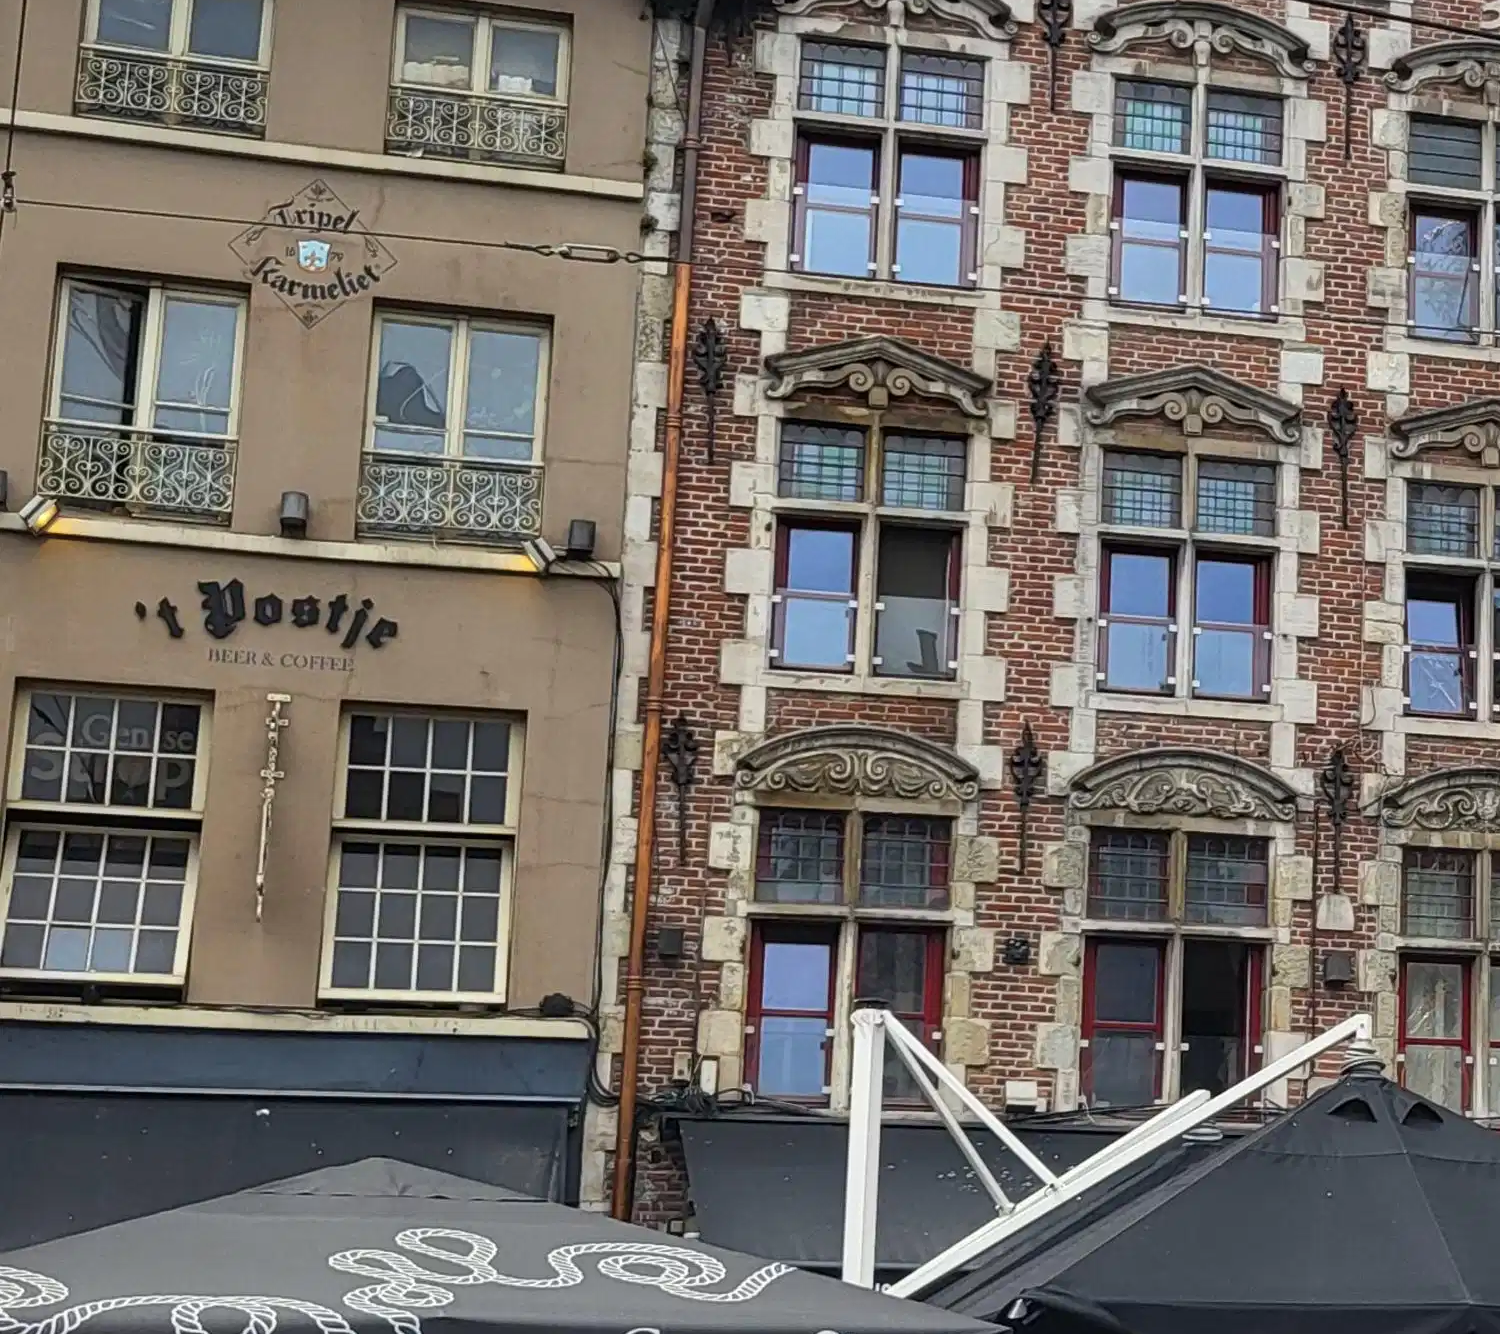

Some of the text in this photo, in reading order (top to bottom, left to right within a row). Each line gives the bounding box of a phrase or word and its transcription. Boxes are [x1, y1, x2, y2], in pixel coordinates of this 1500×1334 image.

[197, 577, 398, 650] Postje
[208, 647, 355, 673] BEER & COFFEE
[81, 713, 195, 751] Gense
